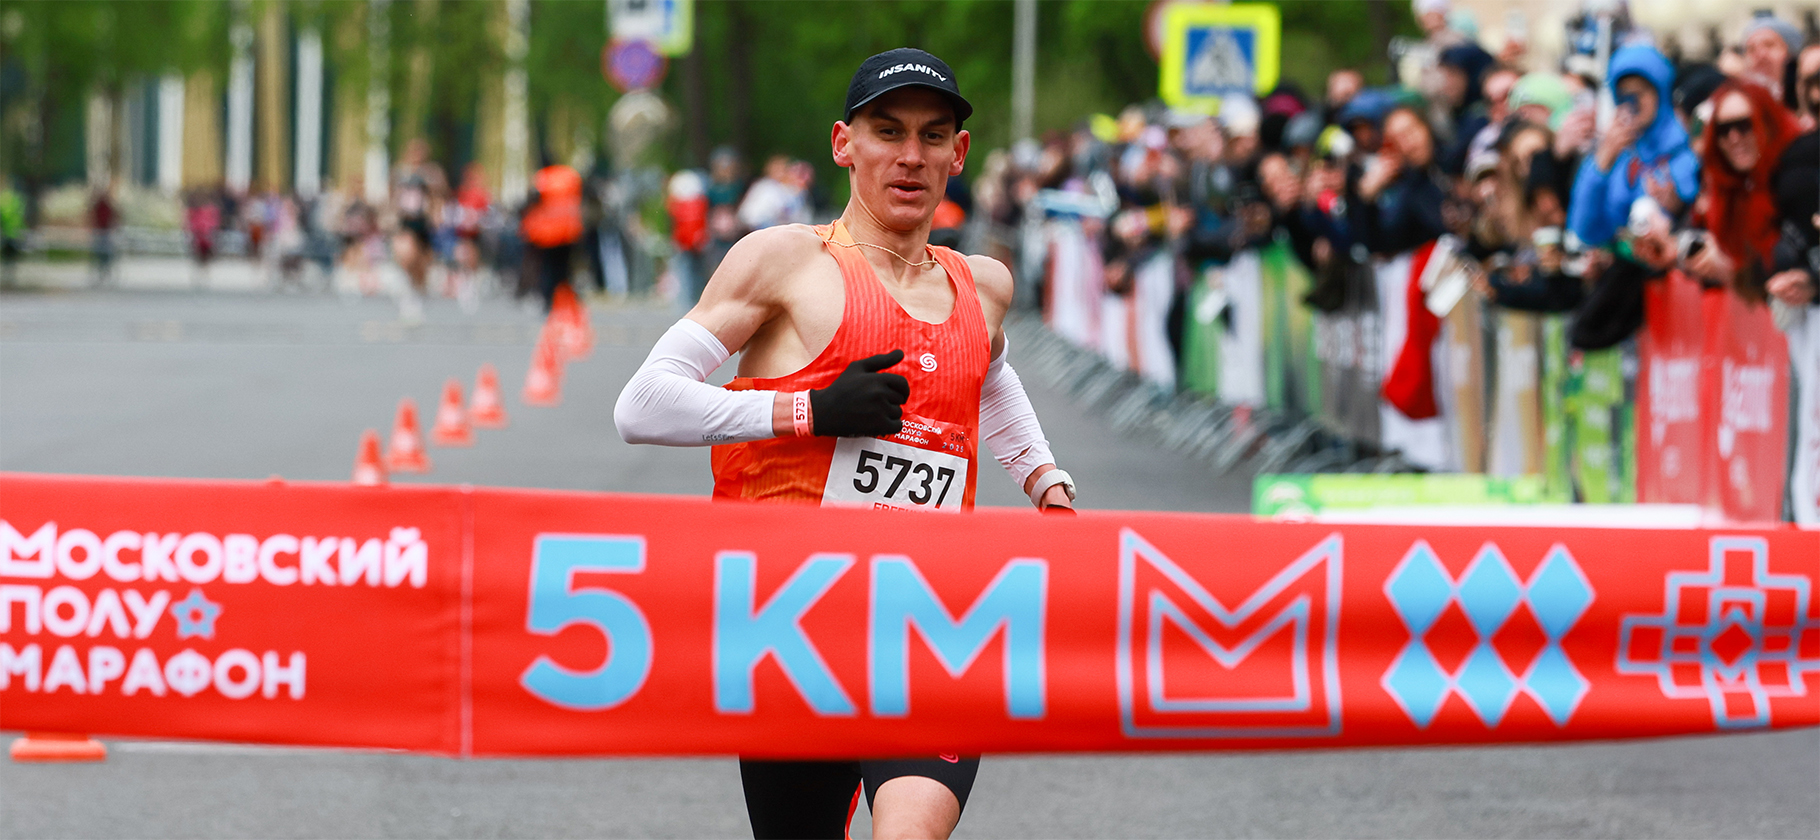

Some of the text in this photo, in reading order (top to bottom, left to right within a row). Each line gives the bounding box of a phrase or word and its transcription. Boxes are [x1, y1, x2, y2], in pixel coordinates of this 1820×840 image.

[878, 63, 947, 82] INSANITY
[795, 397, 805, 421] 5737
[894, 432, 930, 446] МАРАФОН
[901, 427, 917, 436] ОЛУ
[942, 442, 965, 453] 2025
[852, 449, 956, 509] 5737
[0, 584, 171, 638] ПОЛУ
[519, 532, 1049, 720] 5 КМ
[0, 643, 306, 700] МАРАФОН
